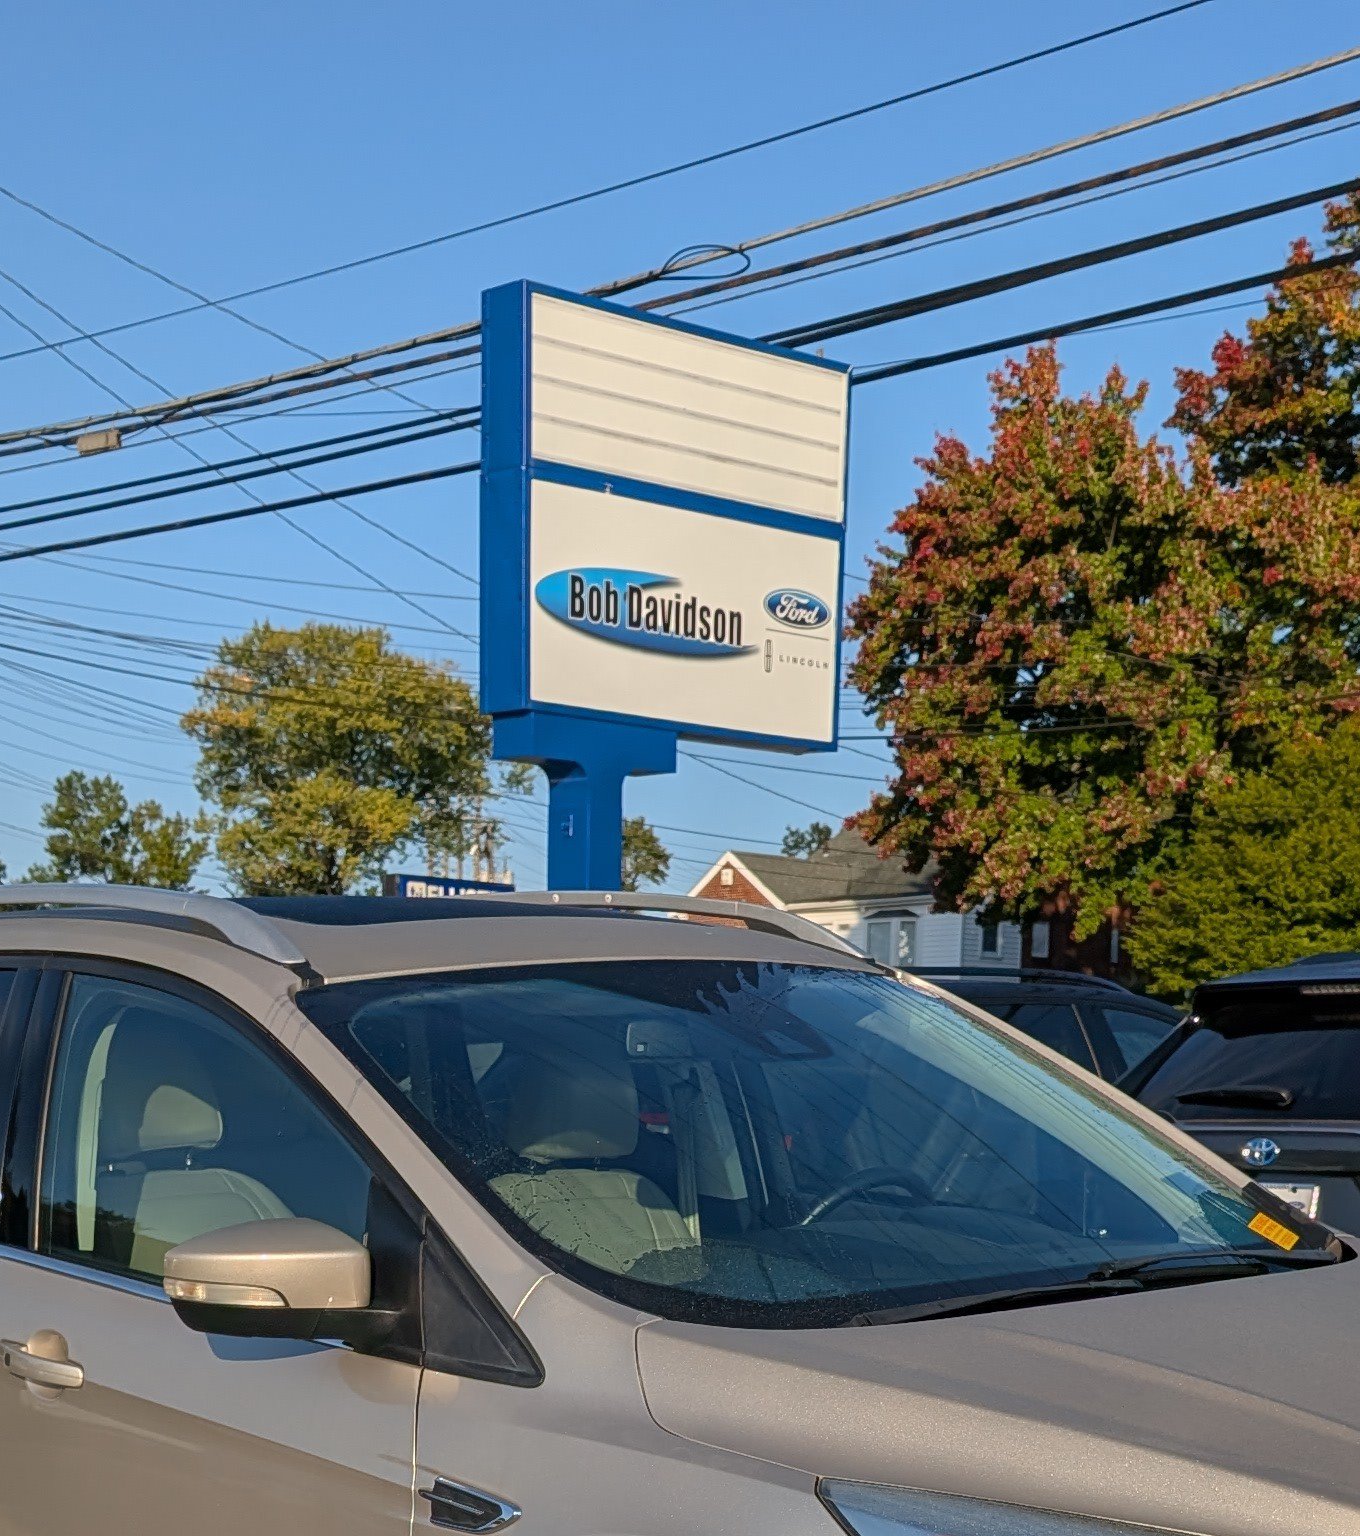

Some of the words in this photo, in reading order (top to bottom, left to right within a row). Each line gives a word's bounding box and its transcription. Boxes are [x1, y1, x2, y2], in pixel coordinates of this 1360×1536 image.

[569, 573, 619, 624] Bob
[625, 584, 743, 646] Davidson
[775, 593, 819, 624] Ford
[778, 654, 830, 670] LINCOLN
